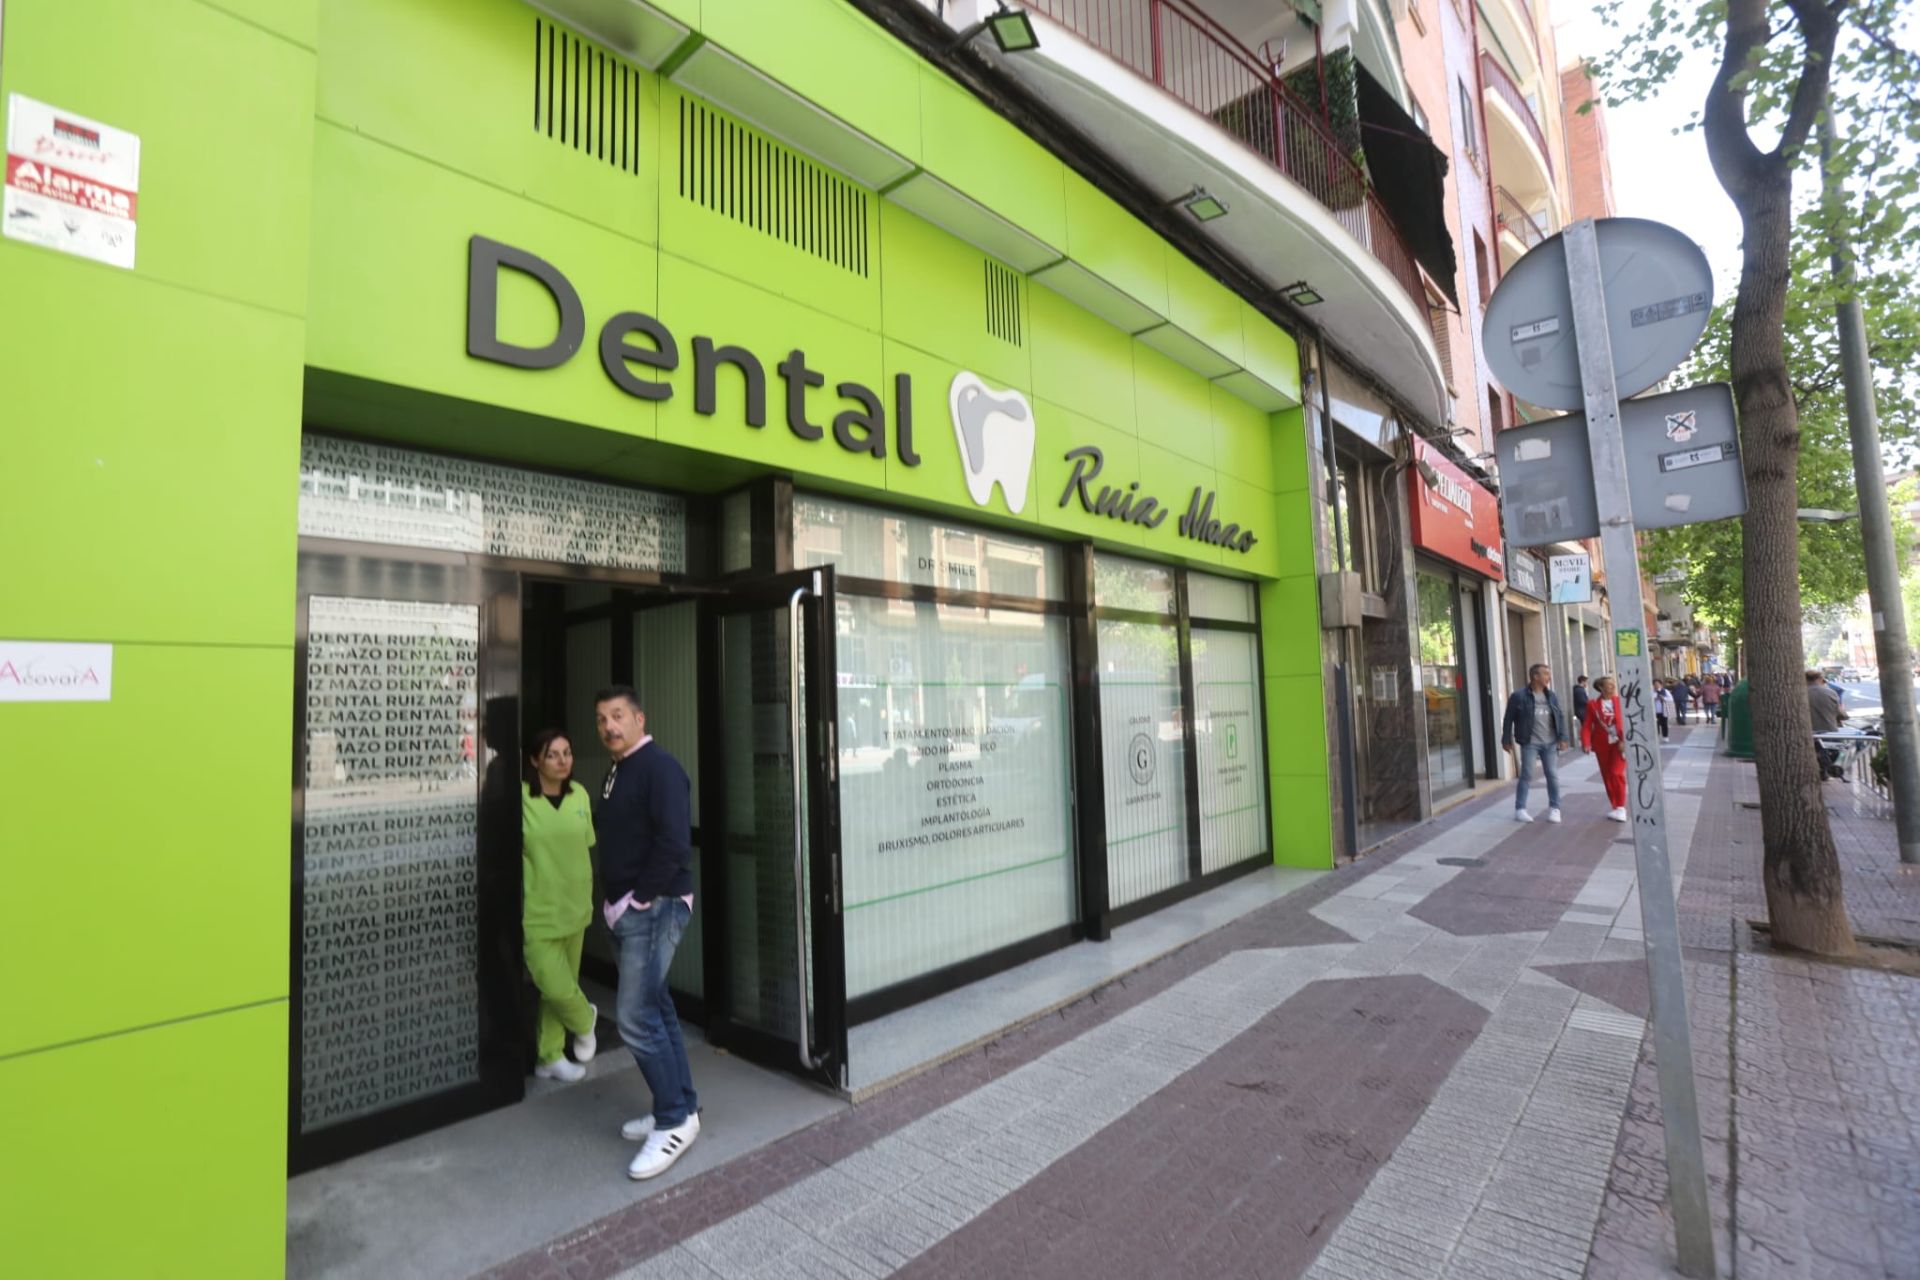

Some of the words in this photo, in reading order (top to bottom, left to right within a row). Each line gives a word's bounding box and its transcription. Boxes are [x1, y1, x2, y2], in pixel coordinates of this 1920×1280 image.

[15, 161, 130, 208] Alarma
[466, 234, 921, 467] Dental
[301, 434, 371, 457] DENTAL
[376, 448, 417, 463] RUIZ
[421, 456, 467, 473] MAZO
[470, 463, 527, 483] DENTAL
[318, 451, 371, 470] MAZO
[375, 461, 443, 482] DENTAL
[446, 473, 480, 487] RUIZ
[484, 479, 526, 495] MAZO
[530, 485, 584, 502] DENTAL
[1059, 445, 1168, 529] Ruiz
[1179, 486, 1258, 554] Mazo
[310, 632, 383, 646] DENTAL
[387, 634, 426, 647] RUIZ
[329, 648, 381, 660] MAZO
[386, 648, 452, 660] DENTAL
[309, 664, 381, 676] DENTAL
[386, 664, 424, 676] RUIZ
[429, 665, 475, 677] MAZO
[329, 679, 381, 691] MAZO
[308, 695, 381, 707] DENTAL
[386, 695, 425, 707] RUIZ
[430, 695, 472, 706] MAZ
[329, 710, 381, 722] MAZO
[386, 710, 452, 722] DENTAL
[385, 725, 425, 738] RUIZ
[385, 739, 452, 752] DENTAL
[884, 727, 953, 741] TATAMENTOS
[385, 755, 425, 769] RUIZ
[938, 760, 973, 773] PLASMA
[1137, 749, 1147, 769] G
[926, 776, 985, 791] ORTODONCIA
[936, 793, 977, 808] ESTÉTICA
[306, 820, 380, 838] DENTAL
[385, 816, 425, 830] RUIZ
[429, 812, 475, 827] MAZO
[921, 808, 991, 828] IMPLANTOLOGÍA
[326, 837, 380, 853] MAZO
[384, 830, 451, 845] DENTAL
[878, 836, 932, 854] BRUXISMO,
[932, 829, 972, 845] DOLORES
[973, 818, 1025, 836] ARTICULARES
[304, 854, 379, 871] DENTAL
[384, 848, 424, 862] RUIZ
[428, 842, 475, 857] MAZO
[304, 884, 379, 904] DENTAL
[384, 879, 424, 895] RUIZ
[428, 872, 475, 888] MAZO
[326, 869, 380, 886] MAZO
[384, 861, 451, 878] DENTAL
[326, 900, 380, 917] MAZO
[384, 892, 451, 909] DENTAL
[305, 916, 380, 938] DENTAL
[385, 909, 425, 925] RUIZ
[429, 901, 476, 918] MAZO
[326, 931, 380, 950] MAZO
[384, 920, 451, 941] DENTAL
[305, 949, 380, 972] DENTAL
[385, 940, 425, 956] RUIZ
[429, 929, 476, 948] MAZO
[326, 963, 380, 984] MAZO
[384, 950, 451, 972] DENTAL
[305, 981, 380, 1005] DENTAL
[385, 971, 425, 988] RUIZ
[429, 960, 476, 979] MAZO
[326, 995, 380, 1017] MAZO
[384, 980, 451, 1003] DENTAL
[305, 1014, 380, 1040] DENTAL
[385, 1003, 425, 1021] RUIZ
[429, 991, 476, 1010] MAZO
[326, 1027, 380, 1050] MAZO
[384, 1011, 451, 1036] DENTAL
[305, 1046, 380, 1073] DENTAL
[385, 1034, 425, 1053] RUIZ
[429, 1022, 476, 1041] MAZO
[325, 1060, 380, 1085] MAZO
[384, 1041, 451, 1067] DENTAL
[303, 1078, 379, 1107] DENTAL
[384, 1066, 424, 1085] RUIZ
[429, 1051, 476, 1072] MAZO
[325, 1092, 380, 1118] MAZO
[384, 1072, 451, 1100] DENTAL
